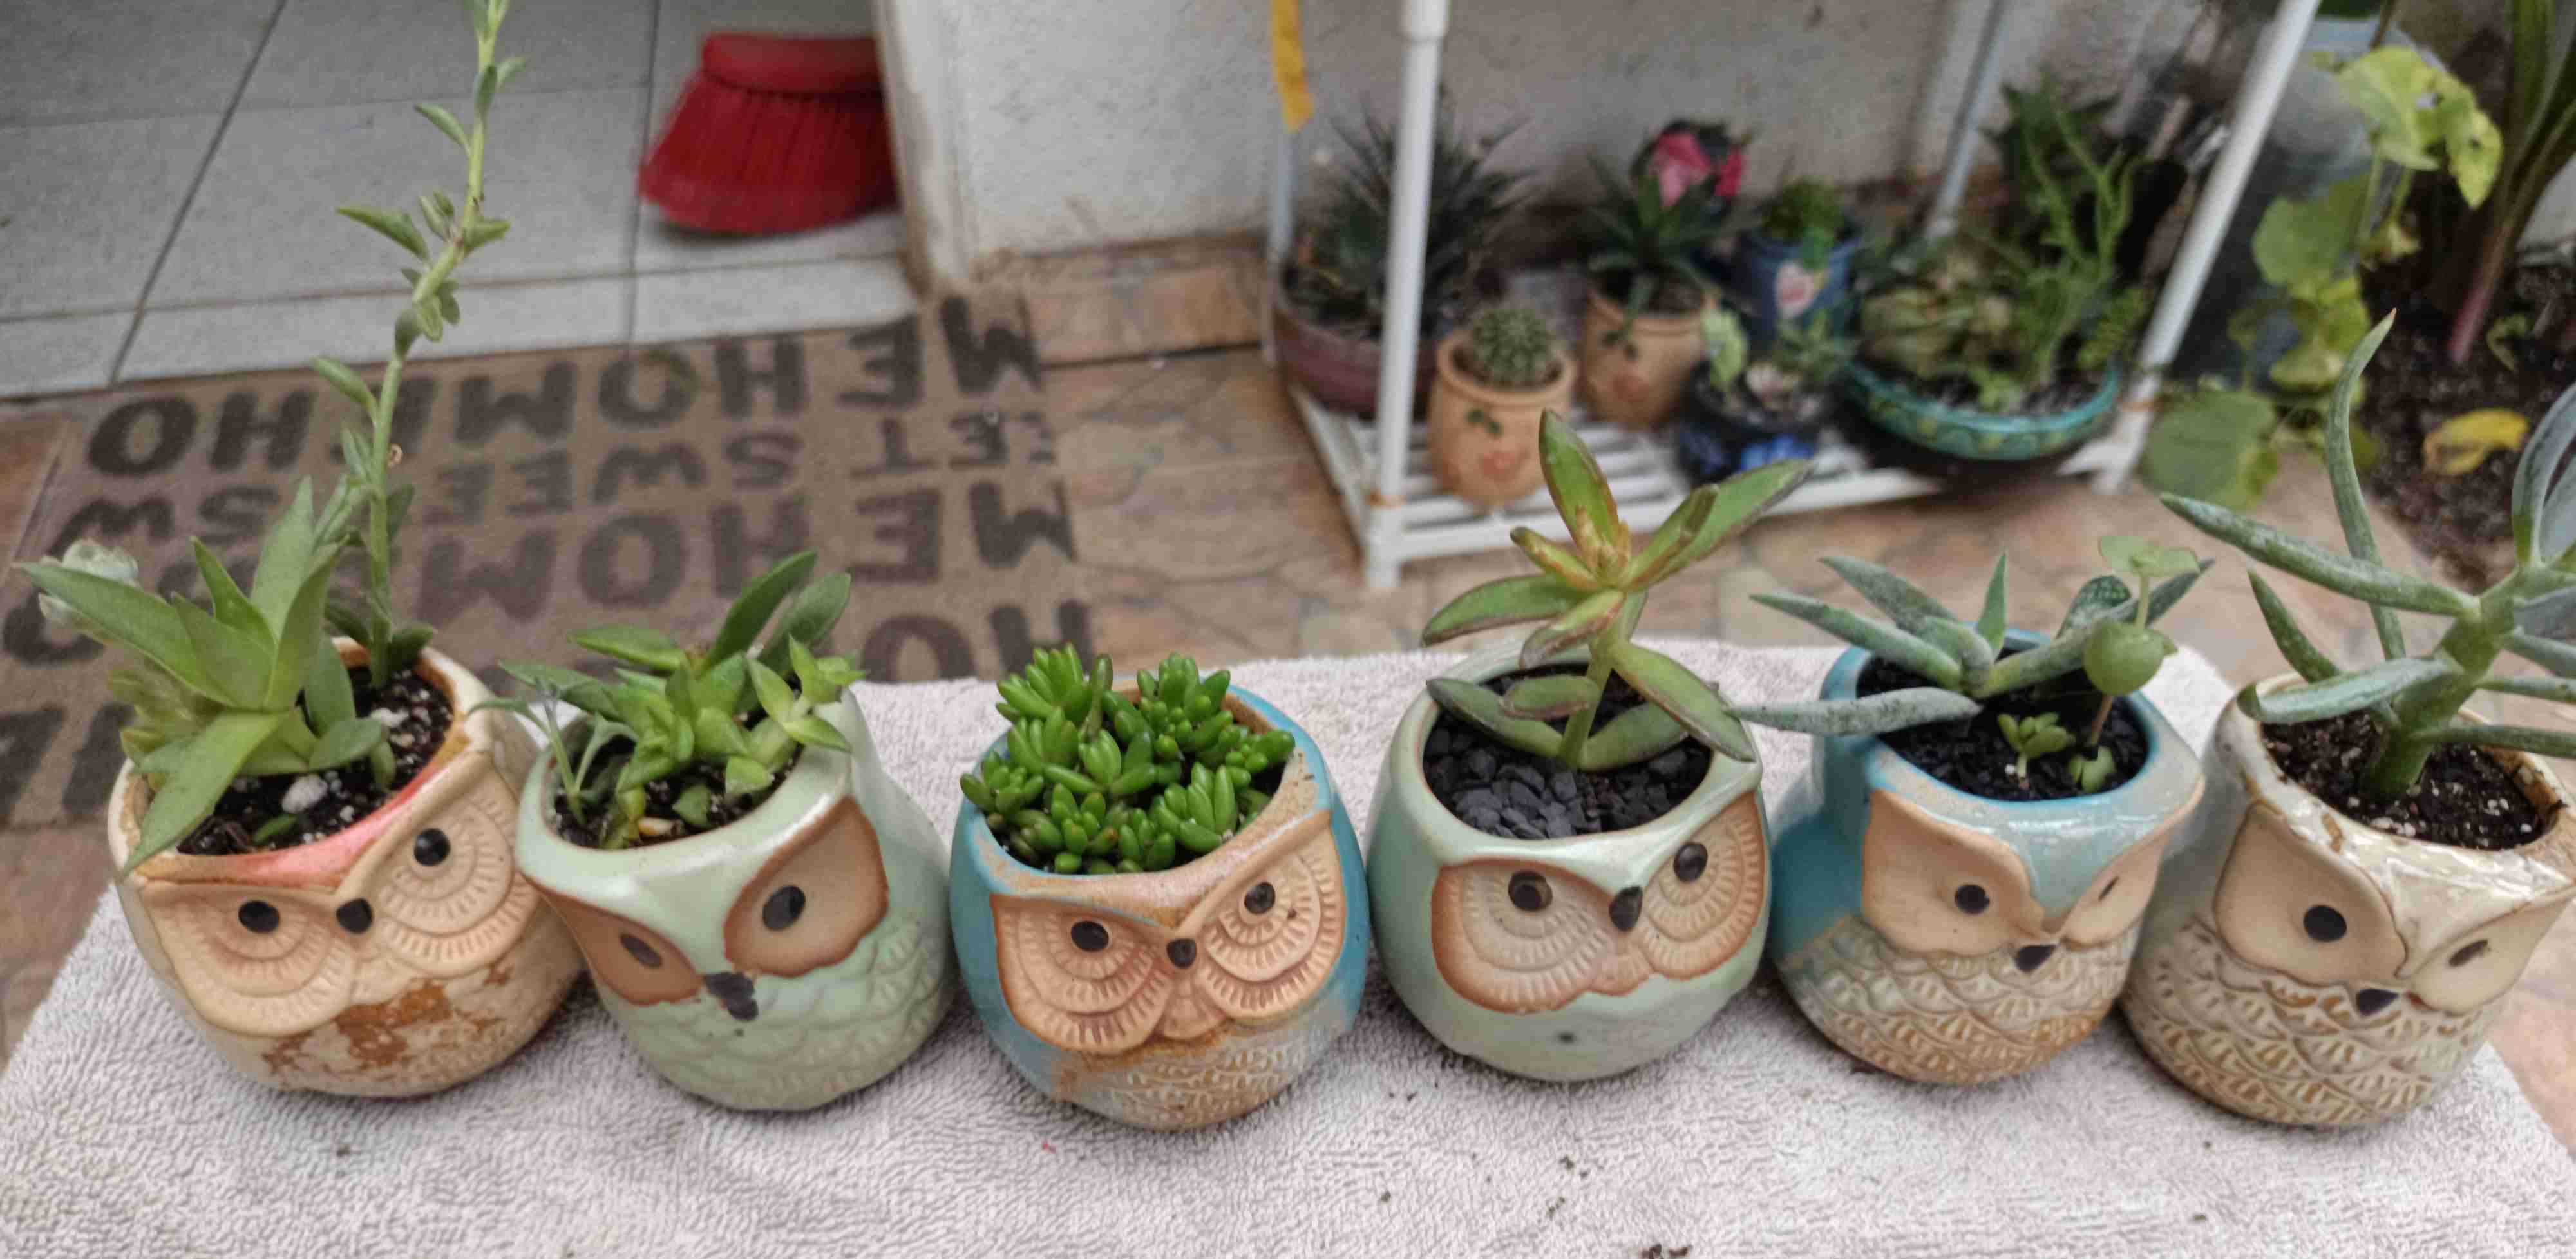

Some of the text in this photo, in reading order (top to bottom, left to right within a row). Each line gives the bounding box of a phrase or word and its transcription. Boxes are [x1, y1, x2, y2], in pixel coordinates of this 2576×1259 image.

[835, 294, 1043, 411] ME
[86, 388, 319, 477] HO
[361, 428, 805, 525] SWEE
[52, 485, 281, 559] SW
[846, 477, 1081, 585] ME
